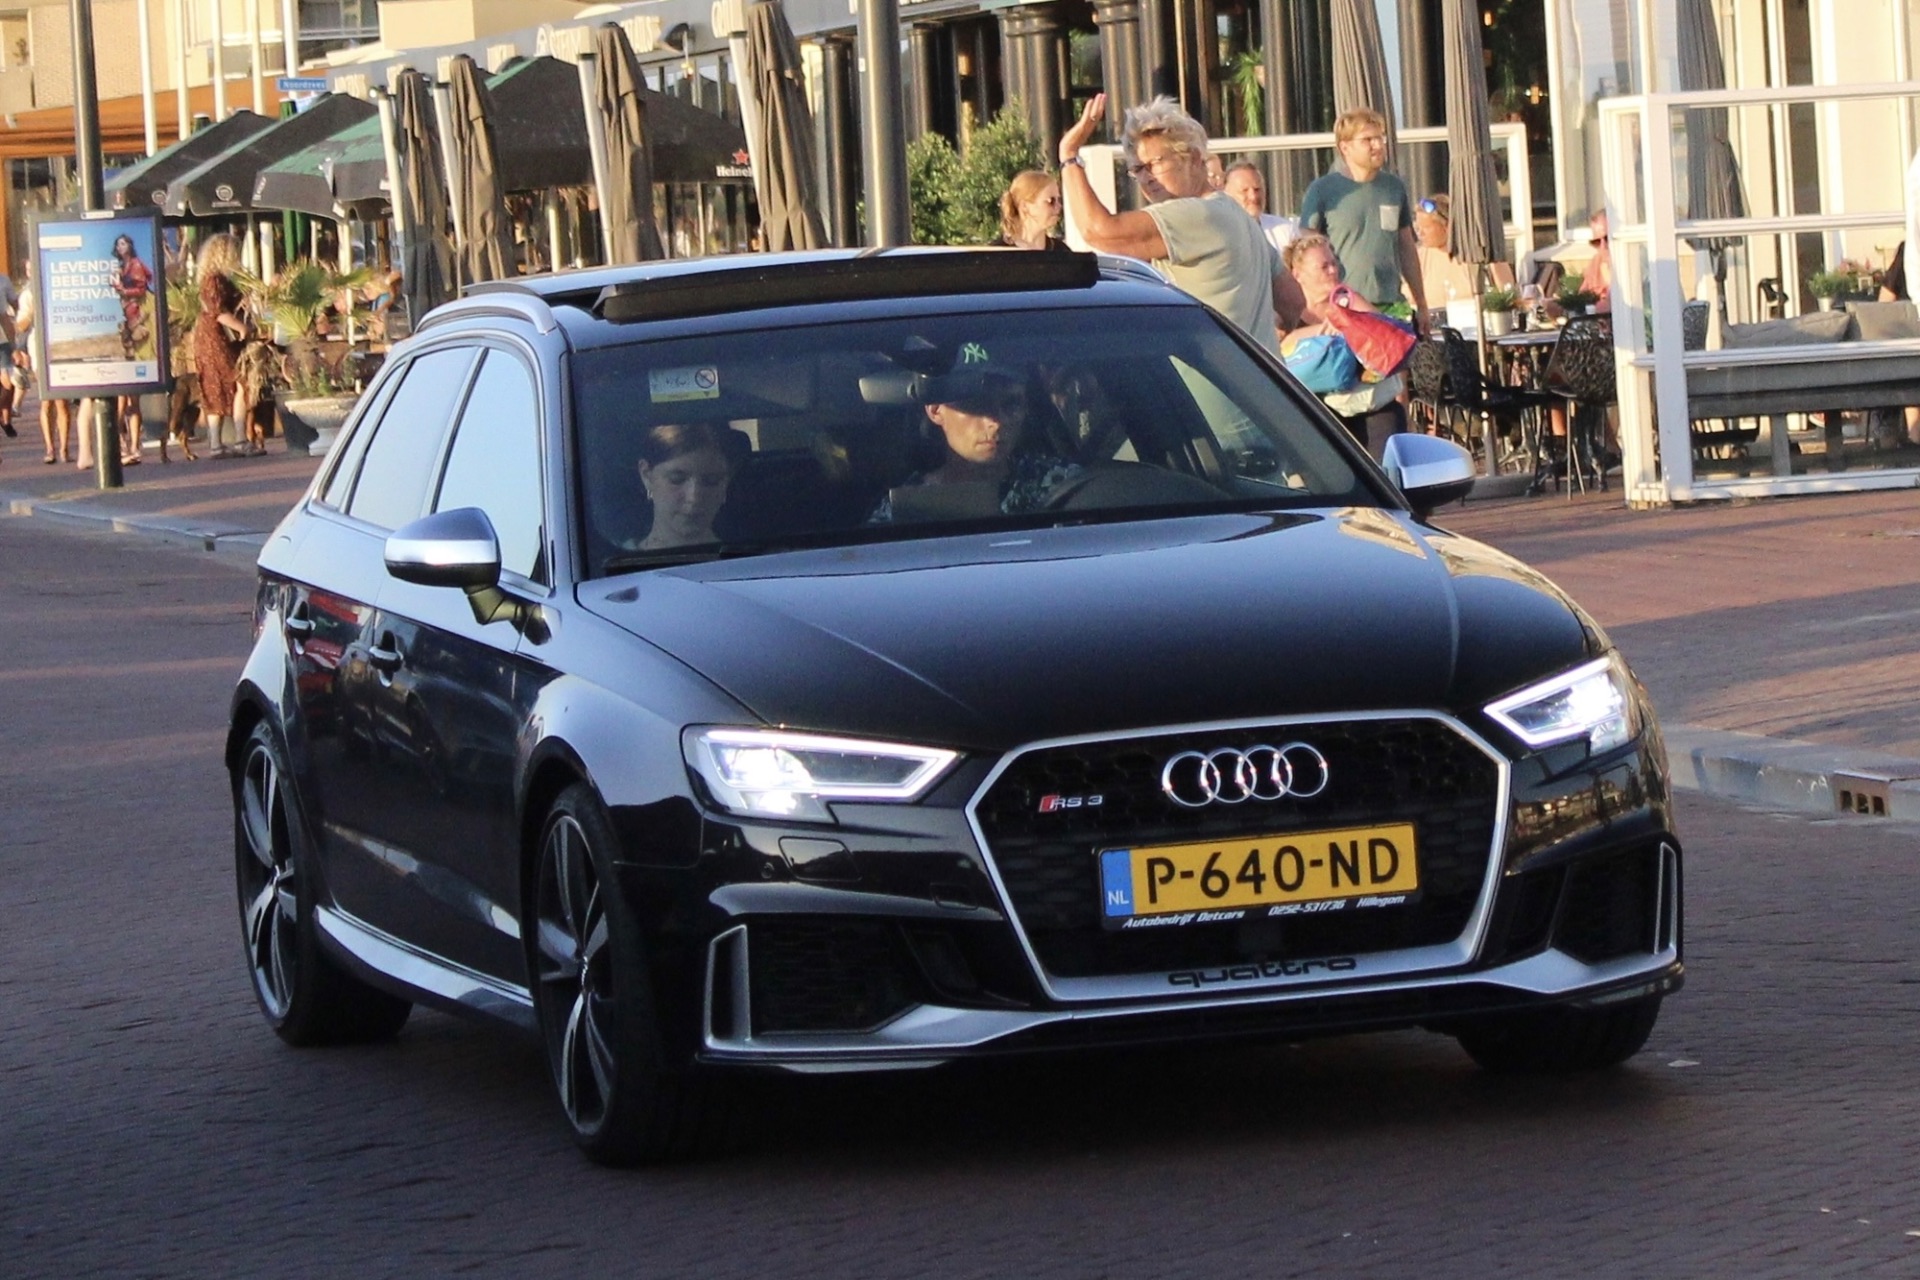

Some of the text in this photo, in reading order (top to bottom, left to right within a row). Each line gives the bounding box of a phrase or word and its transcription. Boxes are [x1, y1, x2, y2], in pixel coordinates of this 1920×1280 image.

[715, 165, 753, 178] Heine
[50, 260, 120, 273] LEVENDE
[51, 273, 120, 287] BEELDEN
[51, 287, 120, 301] FESTIVAL
[53, 304, 94, 314] zondag
[53, 314, 117, 325] 21 augustus
[1146, 838, 1400, 905] P-640-ND
[1108, 889, 1130, 907] NL
[1122, 913, 1195, 929] Autobedrijf
[1356, 895, 1406, 908] Hillegom
[1168, 956, 1357, 988] quattro
